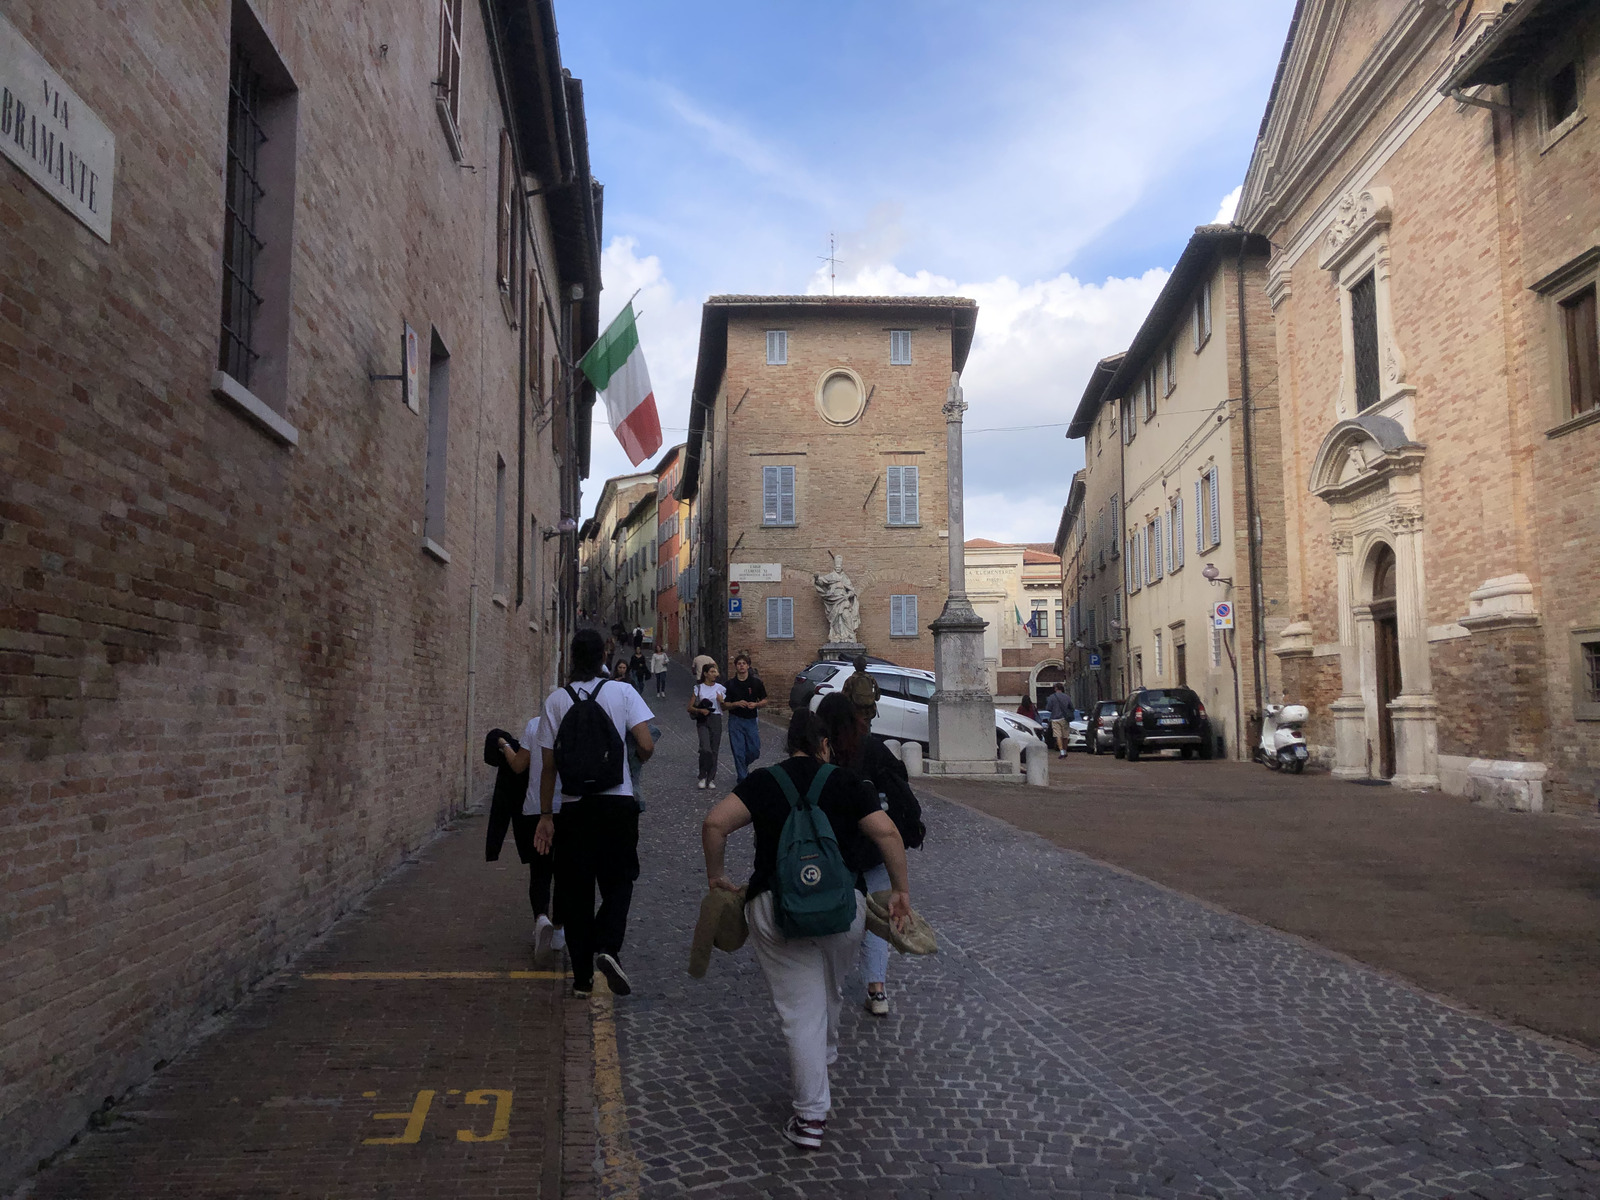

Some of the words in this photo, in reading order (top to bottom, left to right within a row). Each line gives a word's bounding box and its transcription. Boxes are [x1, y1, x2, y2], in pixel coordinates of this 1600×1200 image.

[43, 79, 69, 131] VIA
[1, 86, 99, 214] BRAMANTE
[731, 600, 740, 611] P
[1091, 655, 1099, 664] P
